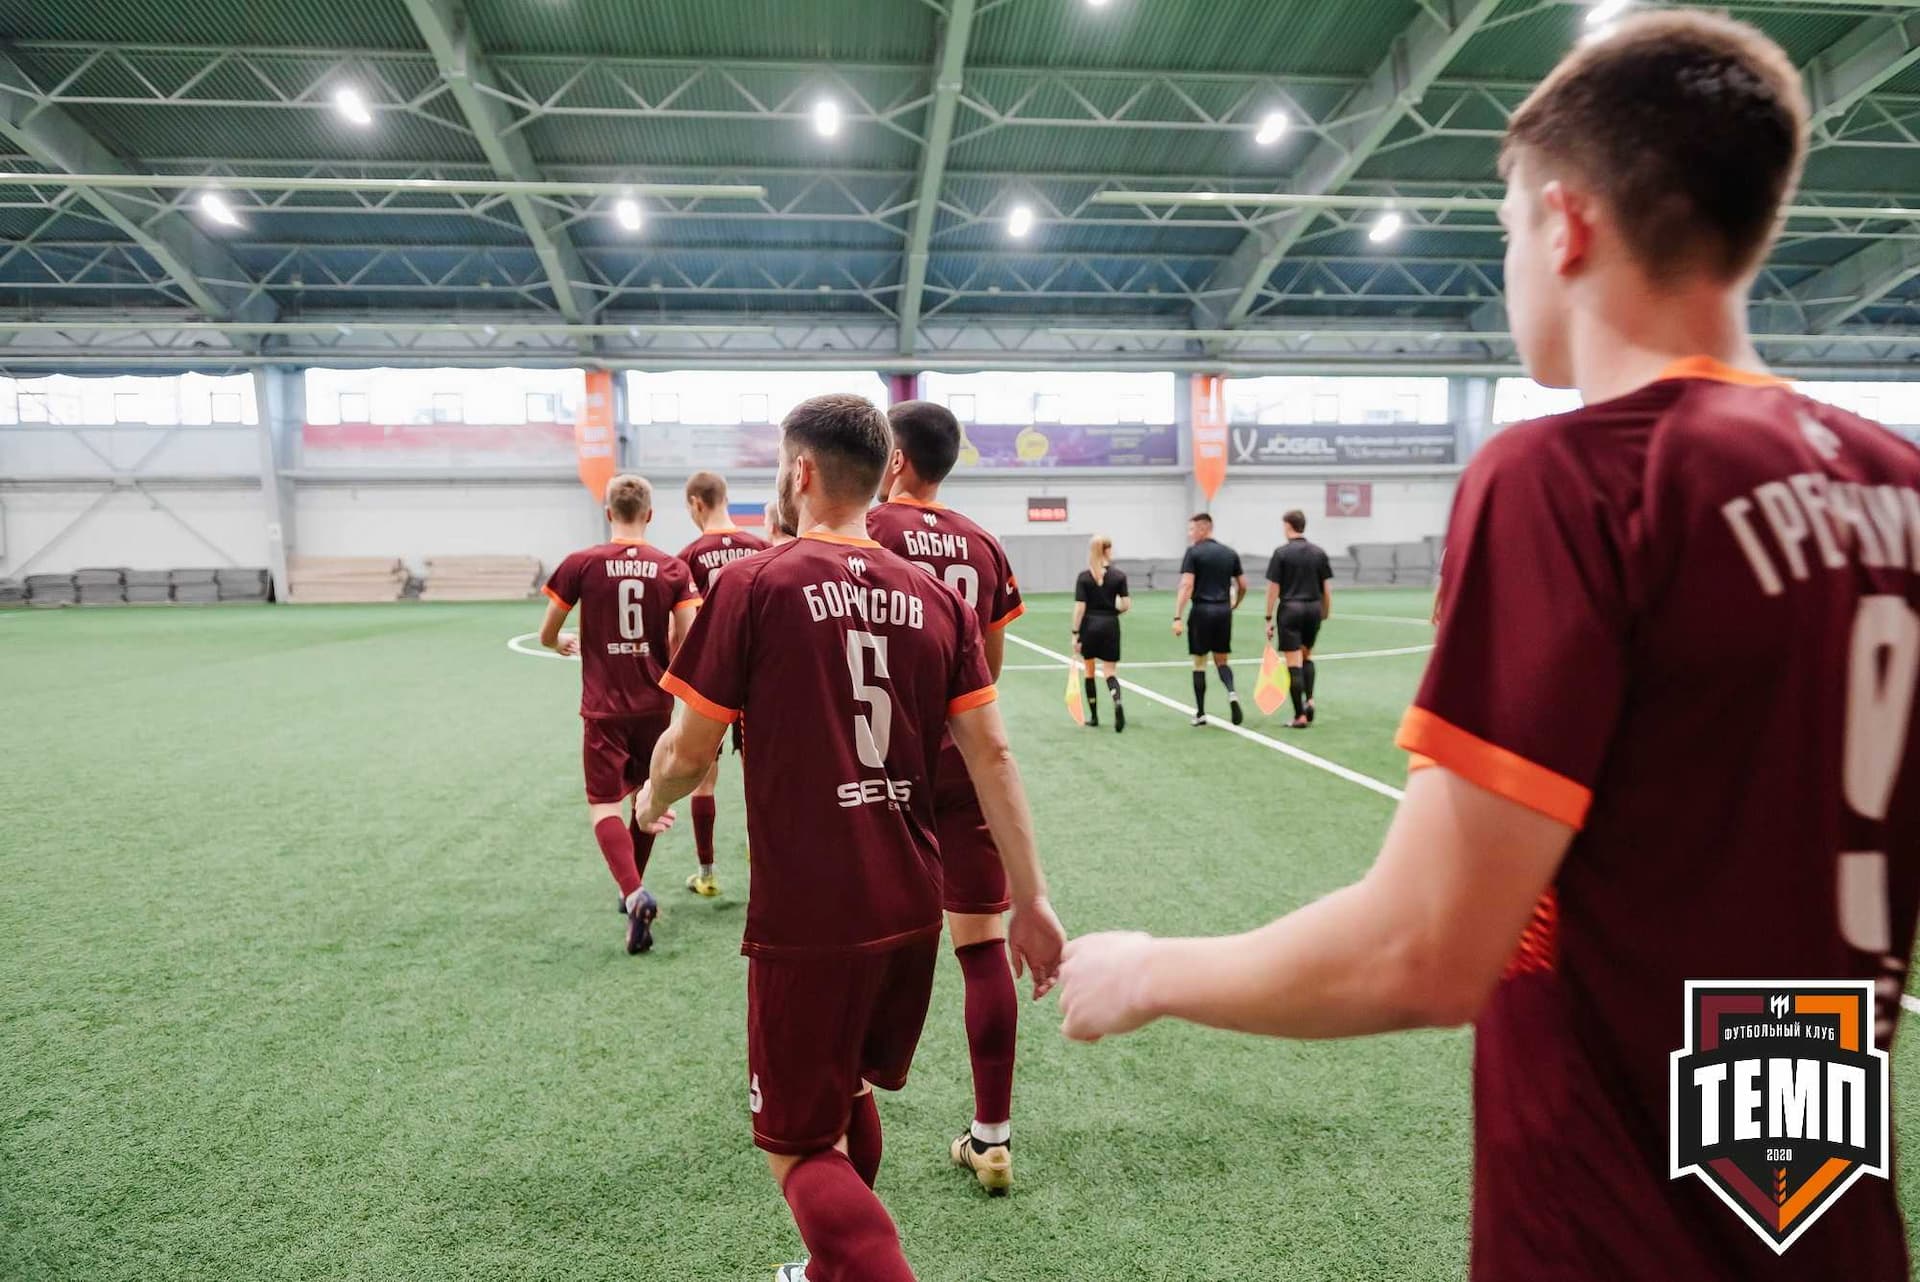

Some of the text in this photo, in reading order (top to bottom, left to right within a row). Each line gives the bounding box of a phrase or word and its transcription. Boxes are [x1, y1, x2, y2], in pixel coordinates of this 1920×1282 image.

[605, 559, 658, 579] КНЯЗЕВ
[903, 530, 969, 561] БАБИЧ
[618, 579, 645, 640] 6
[802, 579, 924, 630] БОРИСОВ
[846, 629, 893, 769] 5
